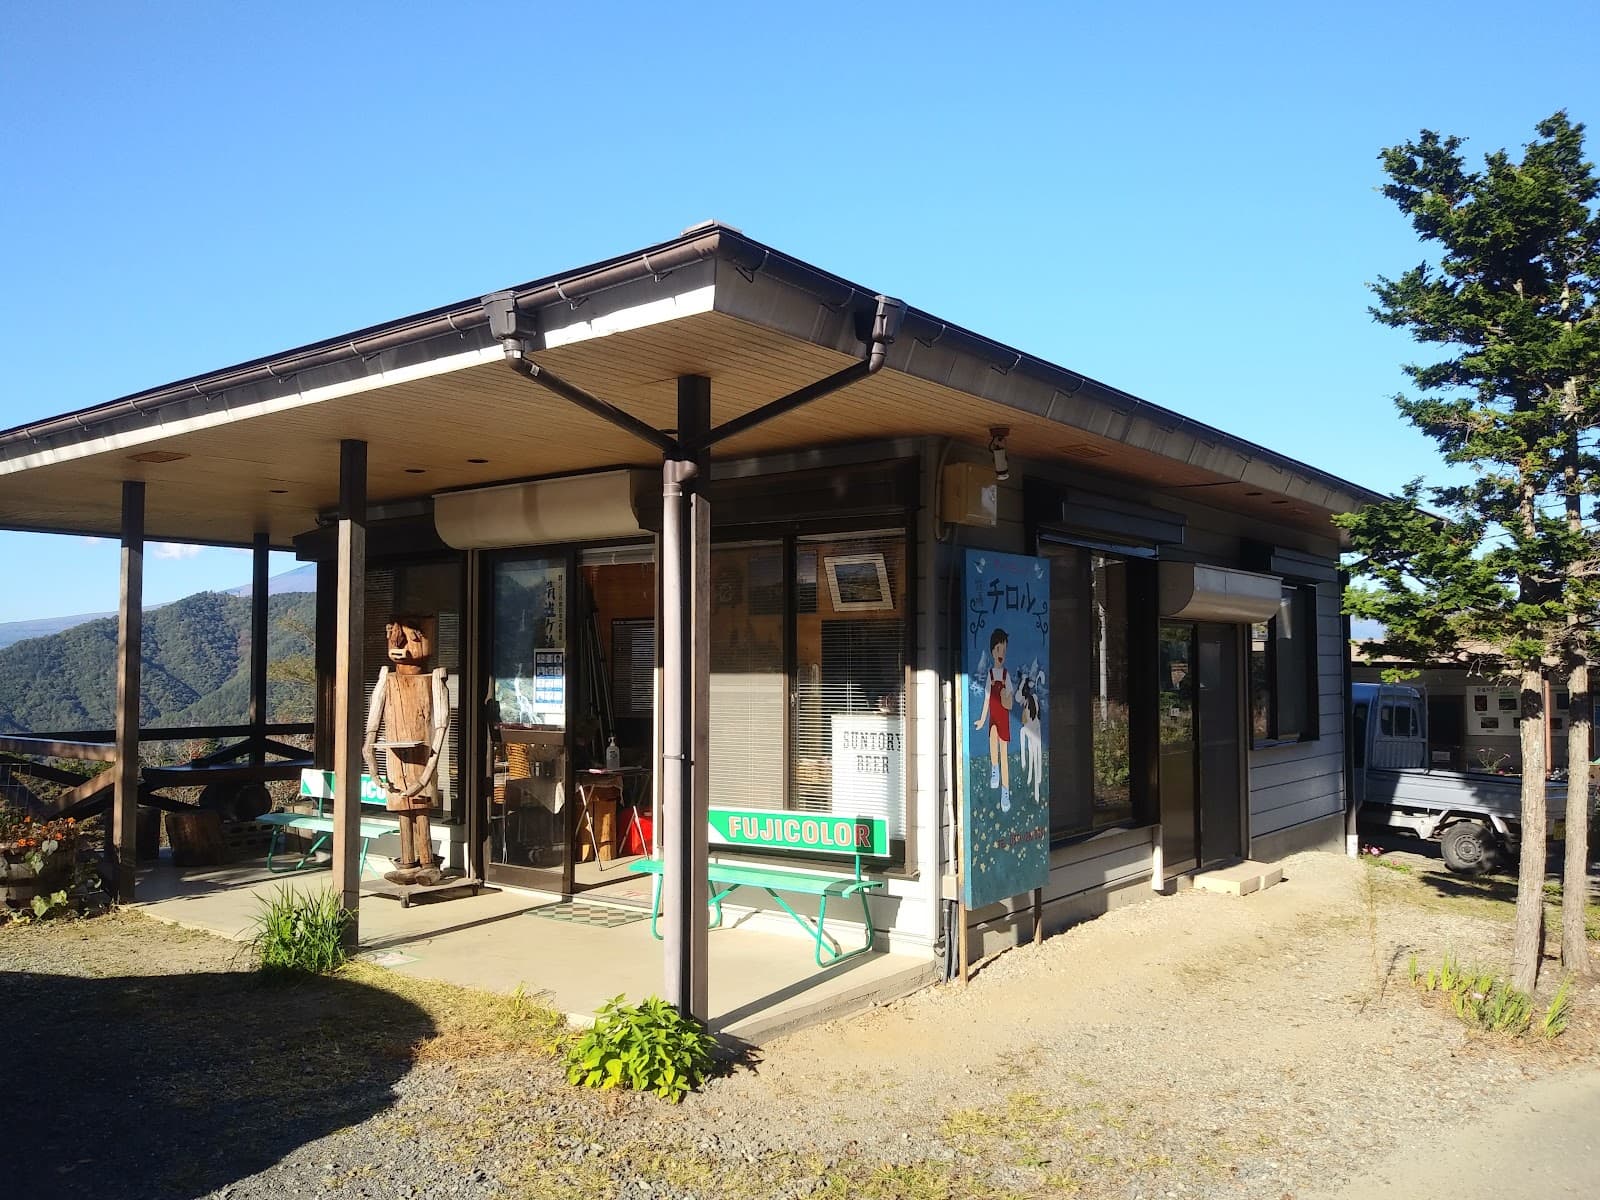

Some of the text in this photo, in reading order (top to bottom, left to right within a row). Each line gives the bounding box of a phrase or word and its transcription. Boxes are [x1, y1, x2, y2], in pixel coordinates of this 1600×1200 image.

[987, 578, 1036, 614] チロル
[843, 730, 904, 752] SUNTORY
[857, 755, 890, 774] BEER
[728, 815, 872, 848] FUJICOLOR
